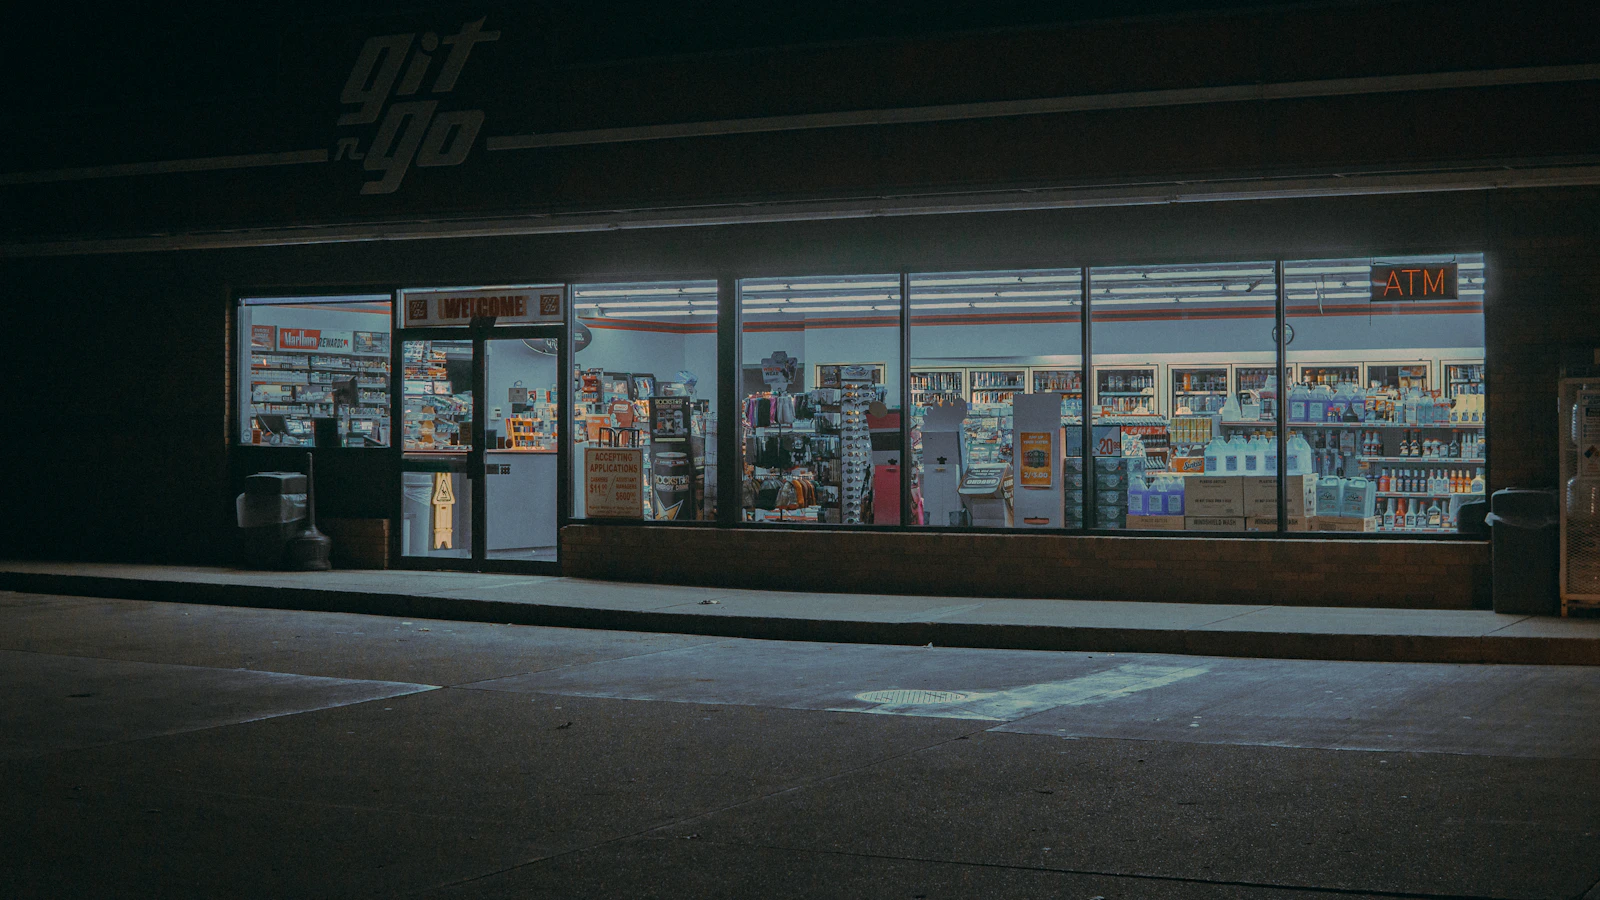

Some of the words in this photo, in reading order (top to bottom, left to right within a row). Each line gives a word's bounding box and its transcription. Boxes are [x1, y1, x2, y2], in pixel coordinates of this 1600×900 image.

[337, 16, 501, 126] git
[360, 100, 485, 195] go
[1383, 268, 1445, 296] ATM
[441, 296, 527, 319] WELCOME
[590, 464, 638, 473] APPLICATIONS
[595, 453, 633, 461] ACCEPTING
